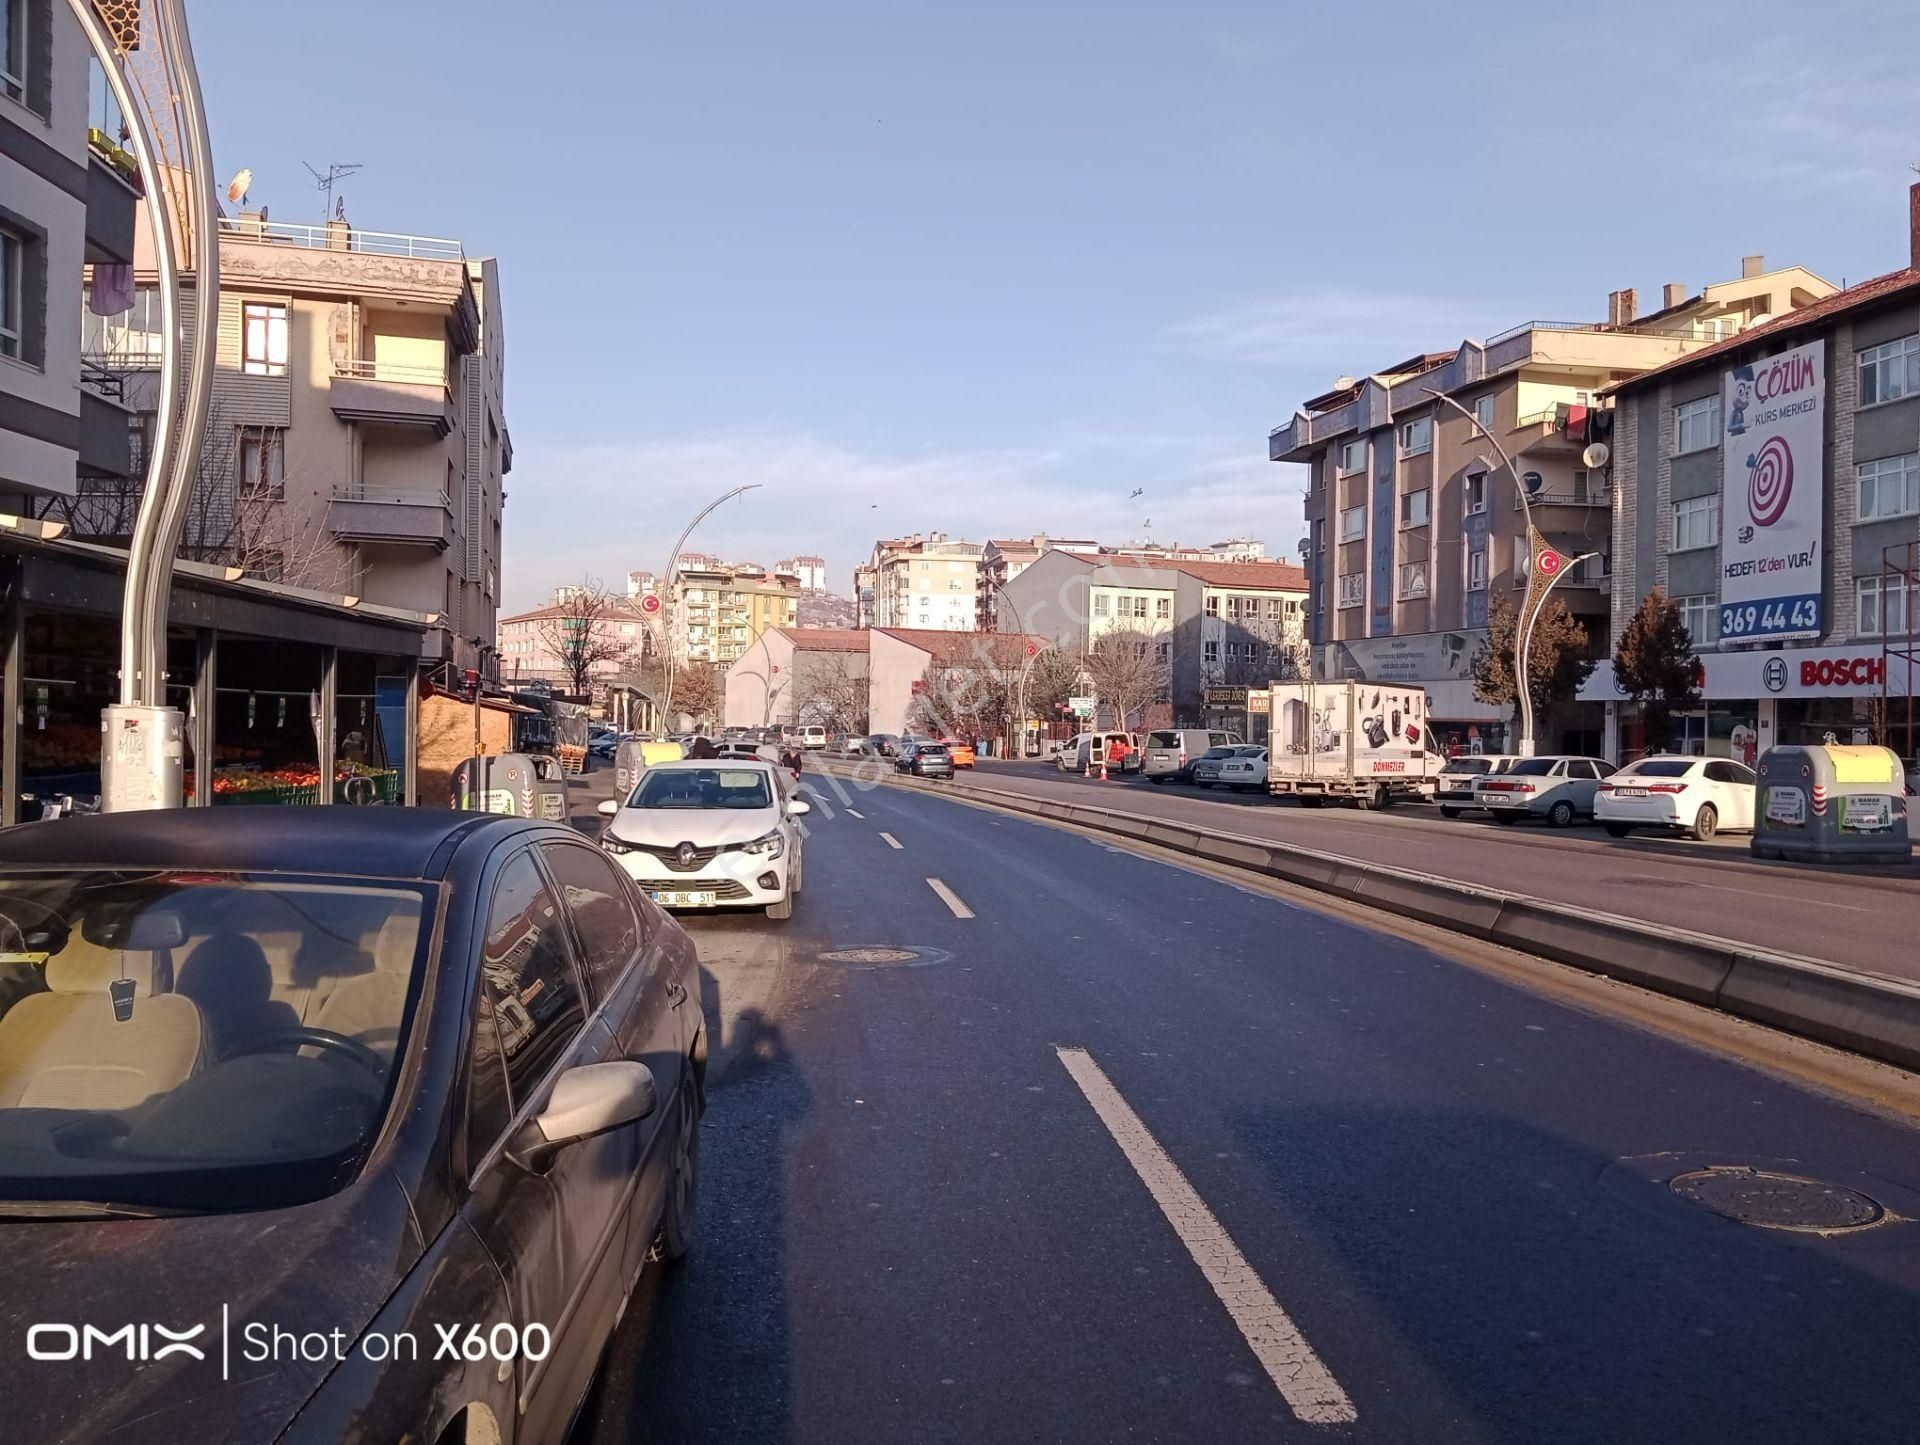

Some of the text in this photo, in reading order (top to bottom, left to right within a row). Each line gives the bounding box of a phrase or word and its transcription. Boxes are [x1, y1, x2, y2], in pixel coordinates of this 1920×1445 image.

[1754, 353, 1815, 404] ÇÖZÜM
[1755, 395, 1816, 425] KURS MERKEZİ
[1788, 541, 1816, 569] VUR!
[1722, 600, 1817, 634] 369 44 43
[1800, 657, 1884, 687] BOSCH
[658, 892, 670, 903] 06
[699, 892, 715, 903] 511
